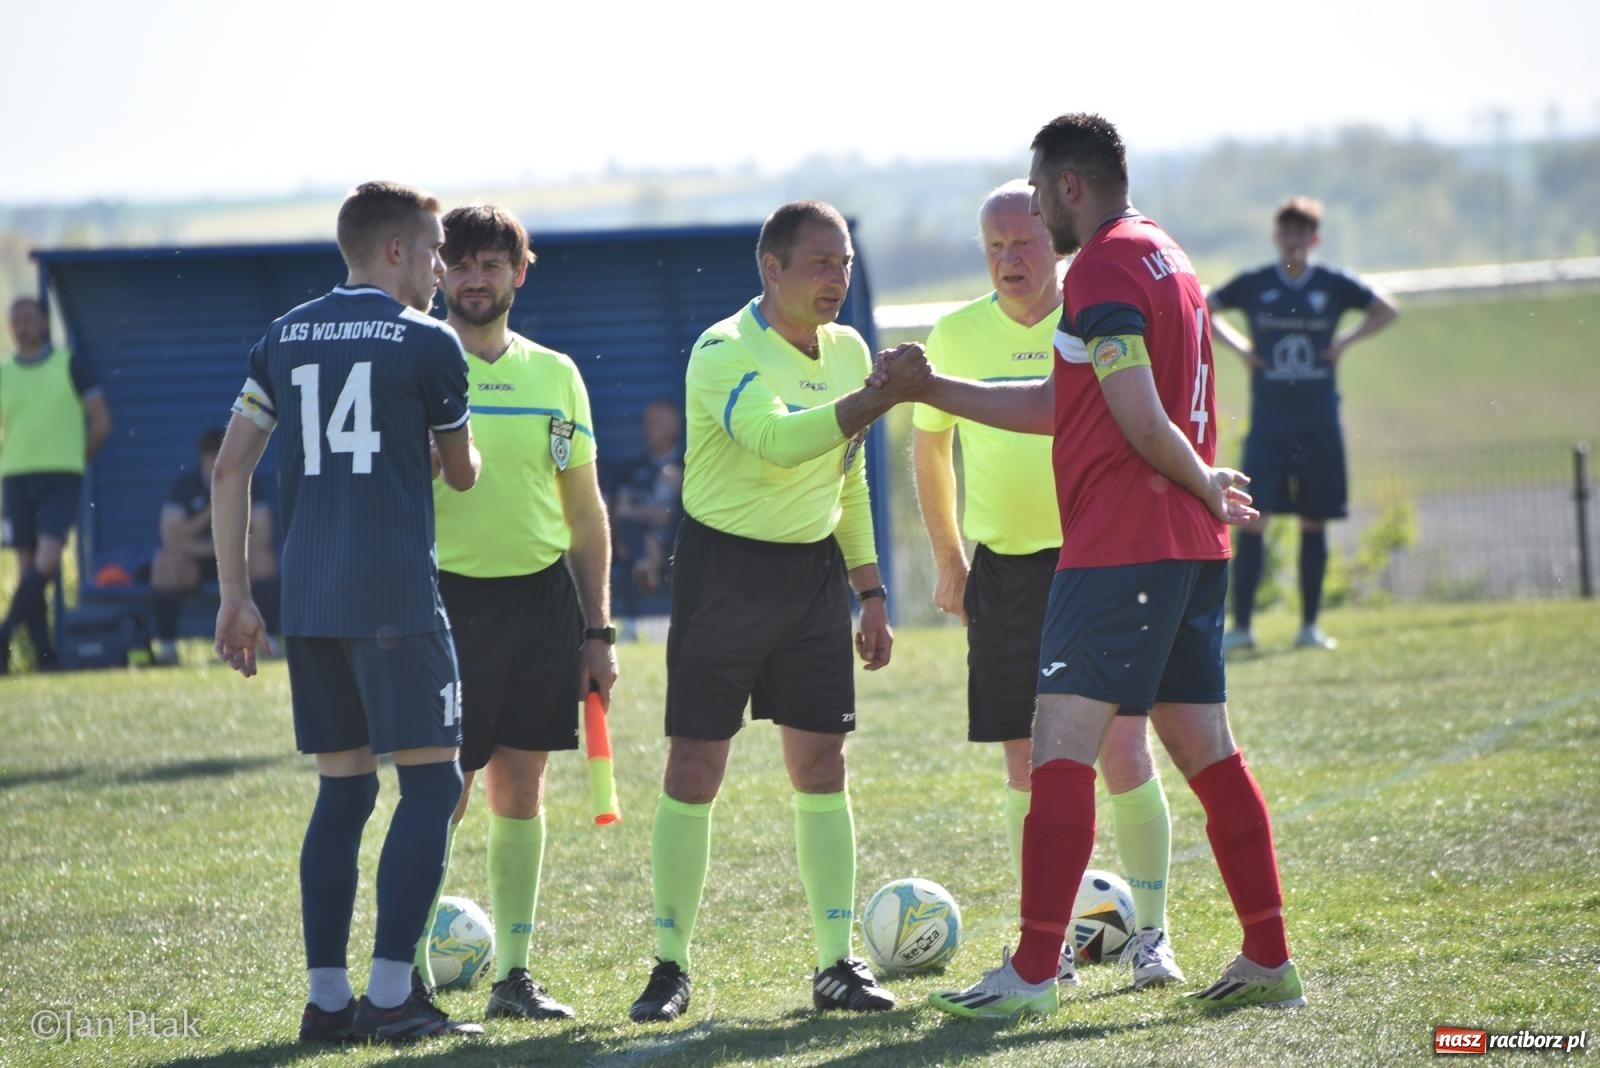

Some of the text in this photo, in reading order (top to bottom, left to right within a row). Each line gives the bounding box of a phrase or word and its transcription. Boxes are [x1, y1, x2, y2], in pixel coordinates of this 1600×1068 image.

[279, 320, 406, 343] LKS WOJNOWICE
[1190, 307, 1209, 444] 4
[291, 361, 381, 475] 14
